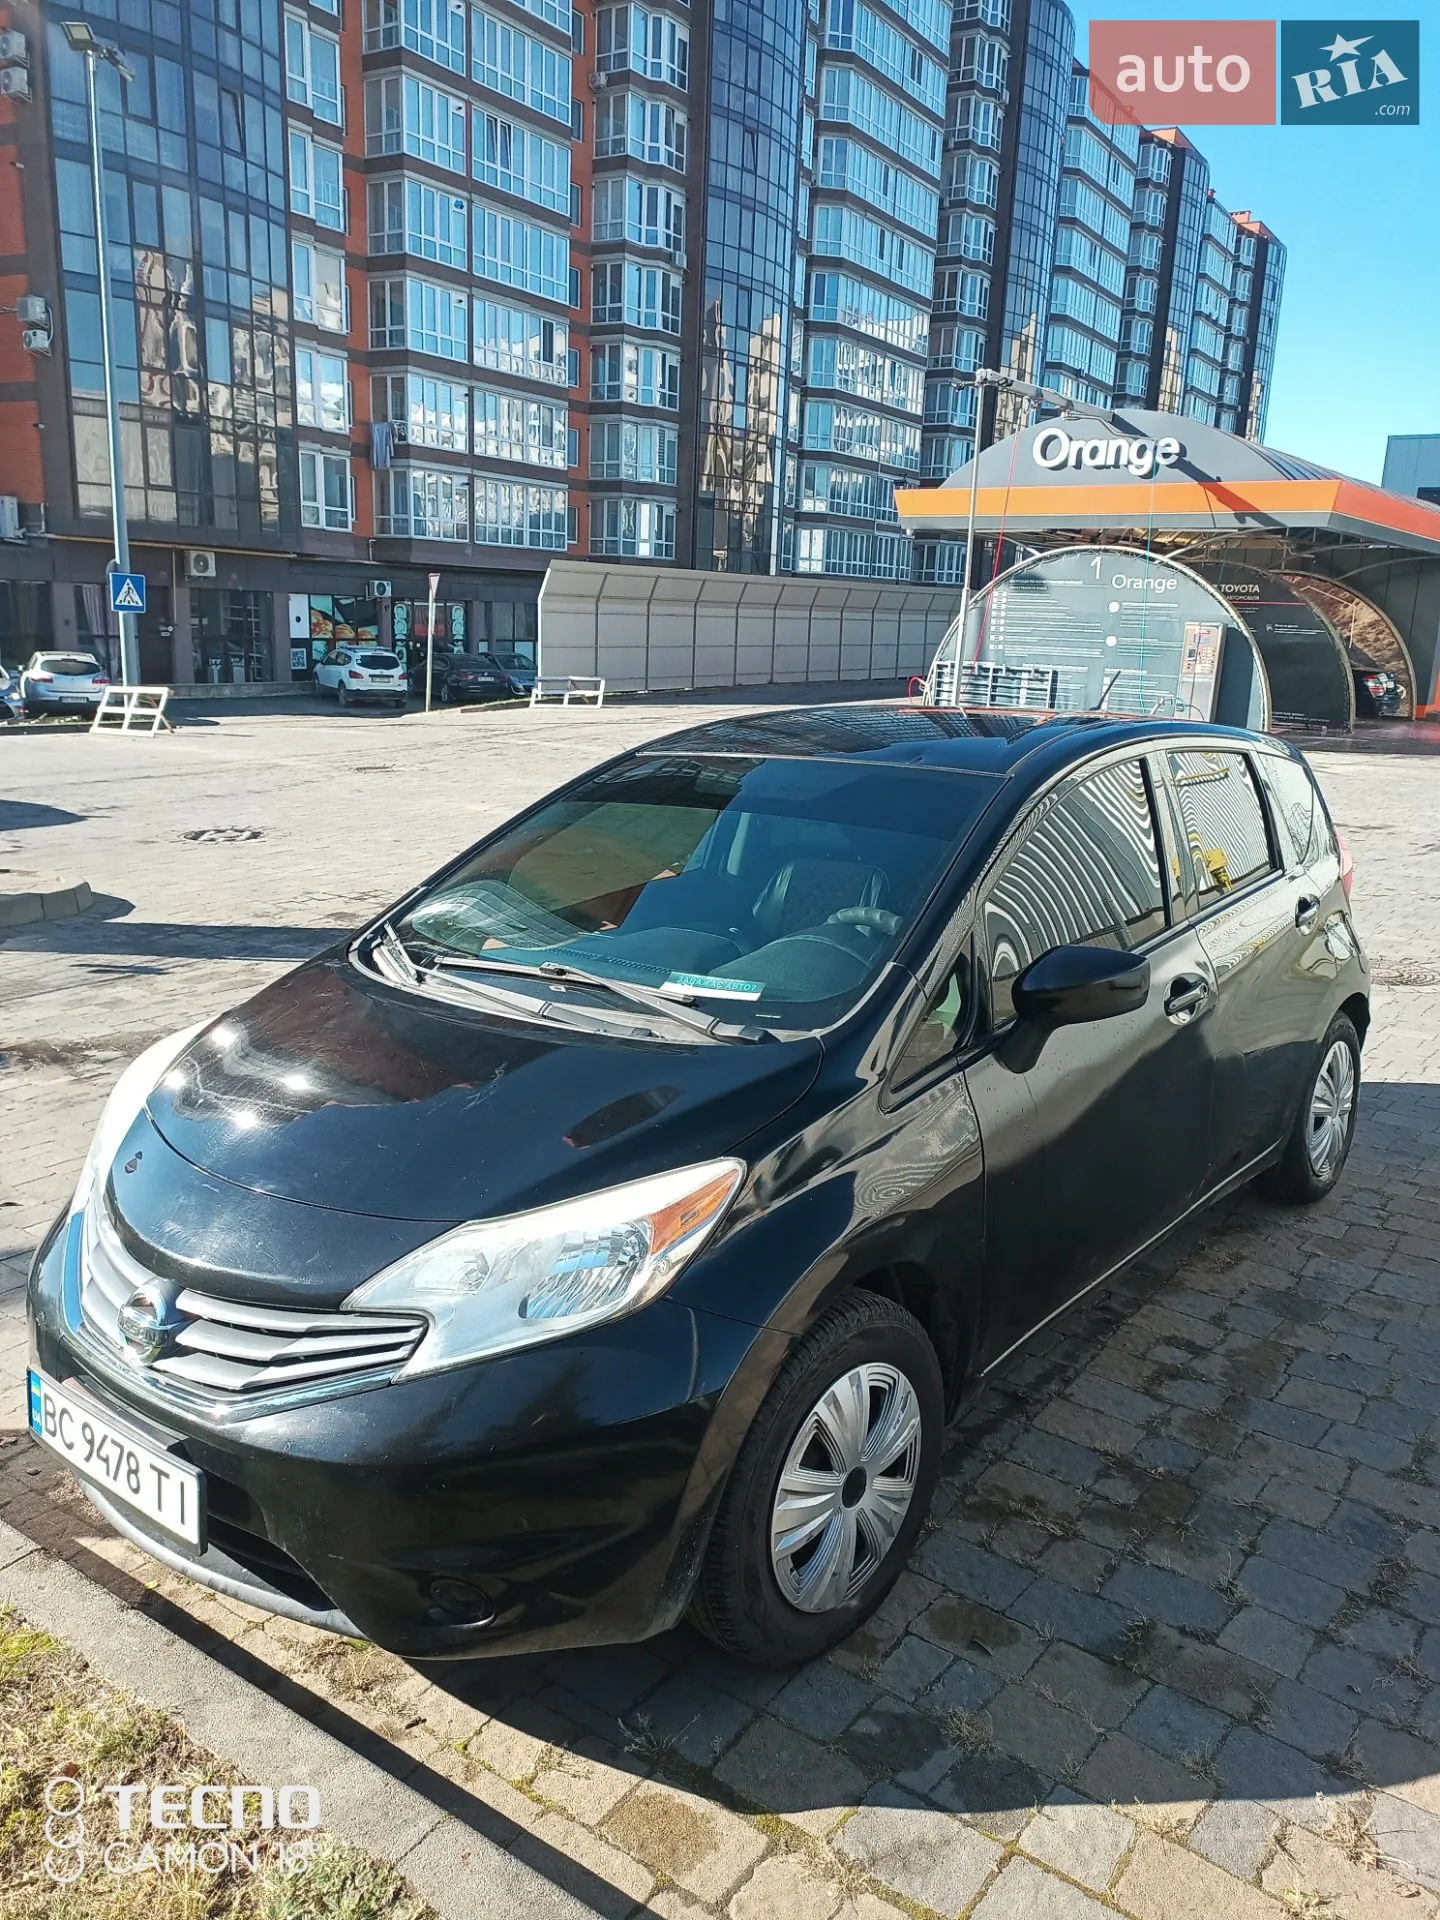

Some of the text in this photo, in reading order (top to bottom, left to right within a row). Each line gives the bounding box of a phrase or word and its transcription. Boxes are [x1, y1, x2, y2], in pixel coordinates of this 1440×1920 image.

[1032, 427, 1180, 476] Orange
[1090, 556, 1102, 579] 1
[1112, 574, 1178, 593] Orange
[1220, 584, 1260, 593] TOYOTA
[724, 981, 757, 991] АВТО?
[43, 1393, 185, 1525] BC 9478 TI
